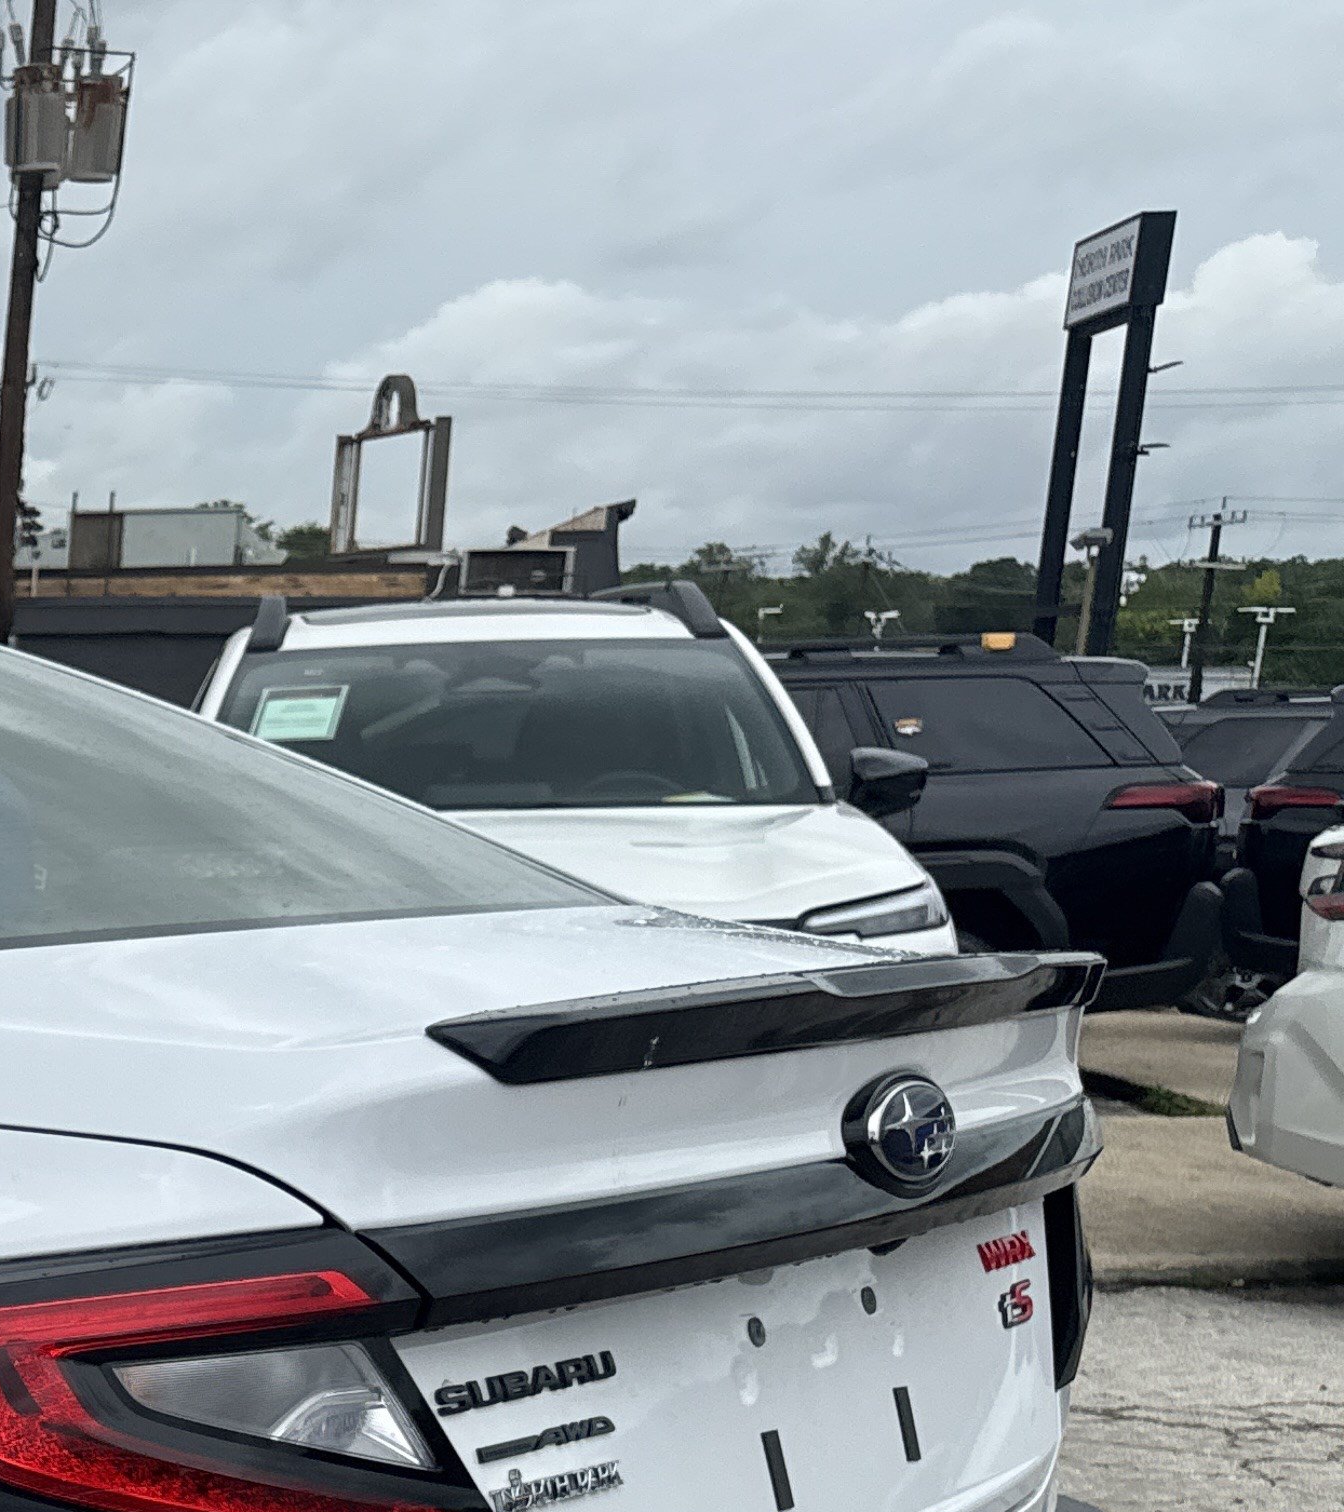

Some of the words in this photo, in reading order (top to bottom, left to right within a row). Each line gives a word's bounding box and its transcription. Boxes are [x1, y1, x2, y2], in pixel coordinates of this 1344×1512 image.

[1143, 684, 1186, 700] ARK
[977, 1230, 1036, 1273] WRX
[434, 1350, 617, 1417] SUBARU
